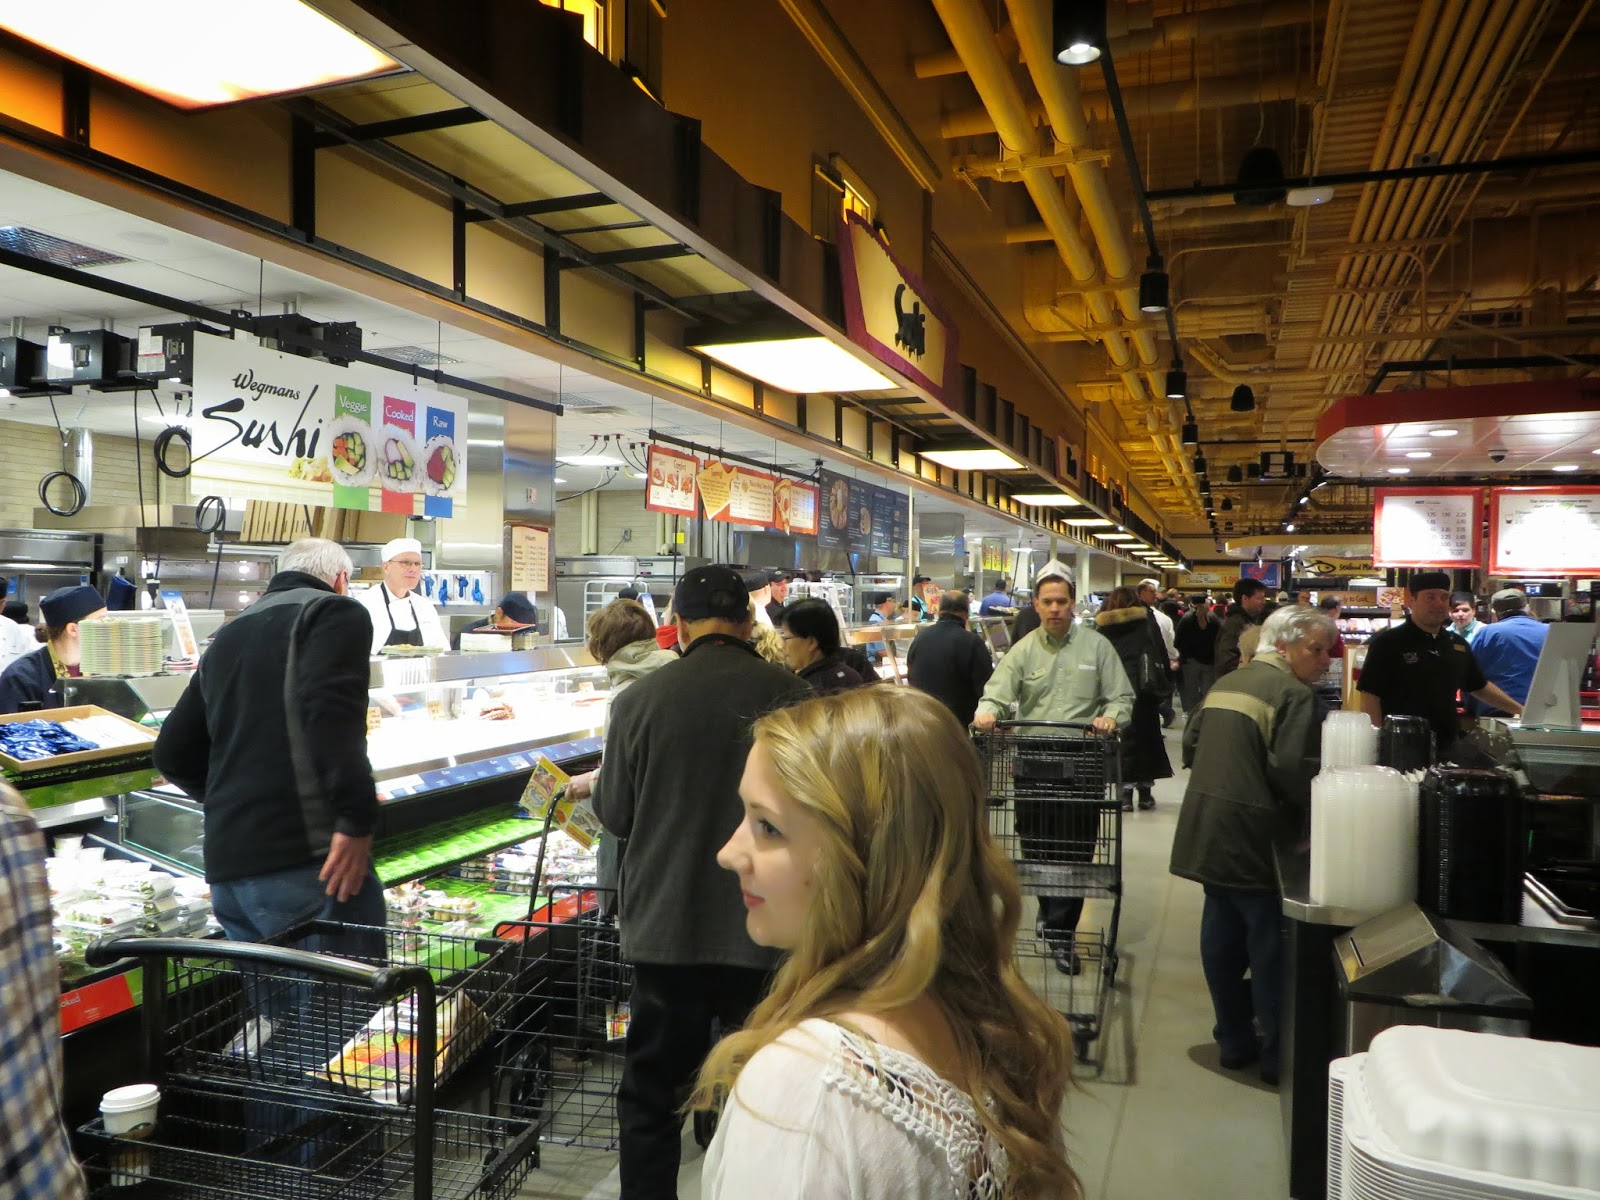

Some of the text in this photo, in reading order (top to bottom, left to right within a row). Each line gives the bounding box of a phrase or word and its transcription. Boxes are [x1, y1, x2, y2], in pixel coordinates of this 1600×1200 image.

[232, 368, 301, 402] Wegmans
[339, 395, 368, 414] Veggie
[385, 404, 415, 422] Cooked
[191, 384, 323, 463] Sushi
[433, 415, 448, 429] Raw
[1340, 562, 1361, 571] Seafood
[60, 992, 80, 1008] oked
